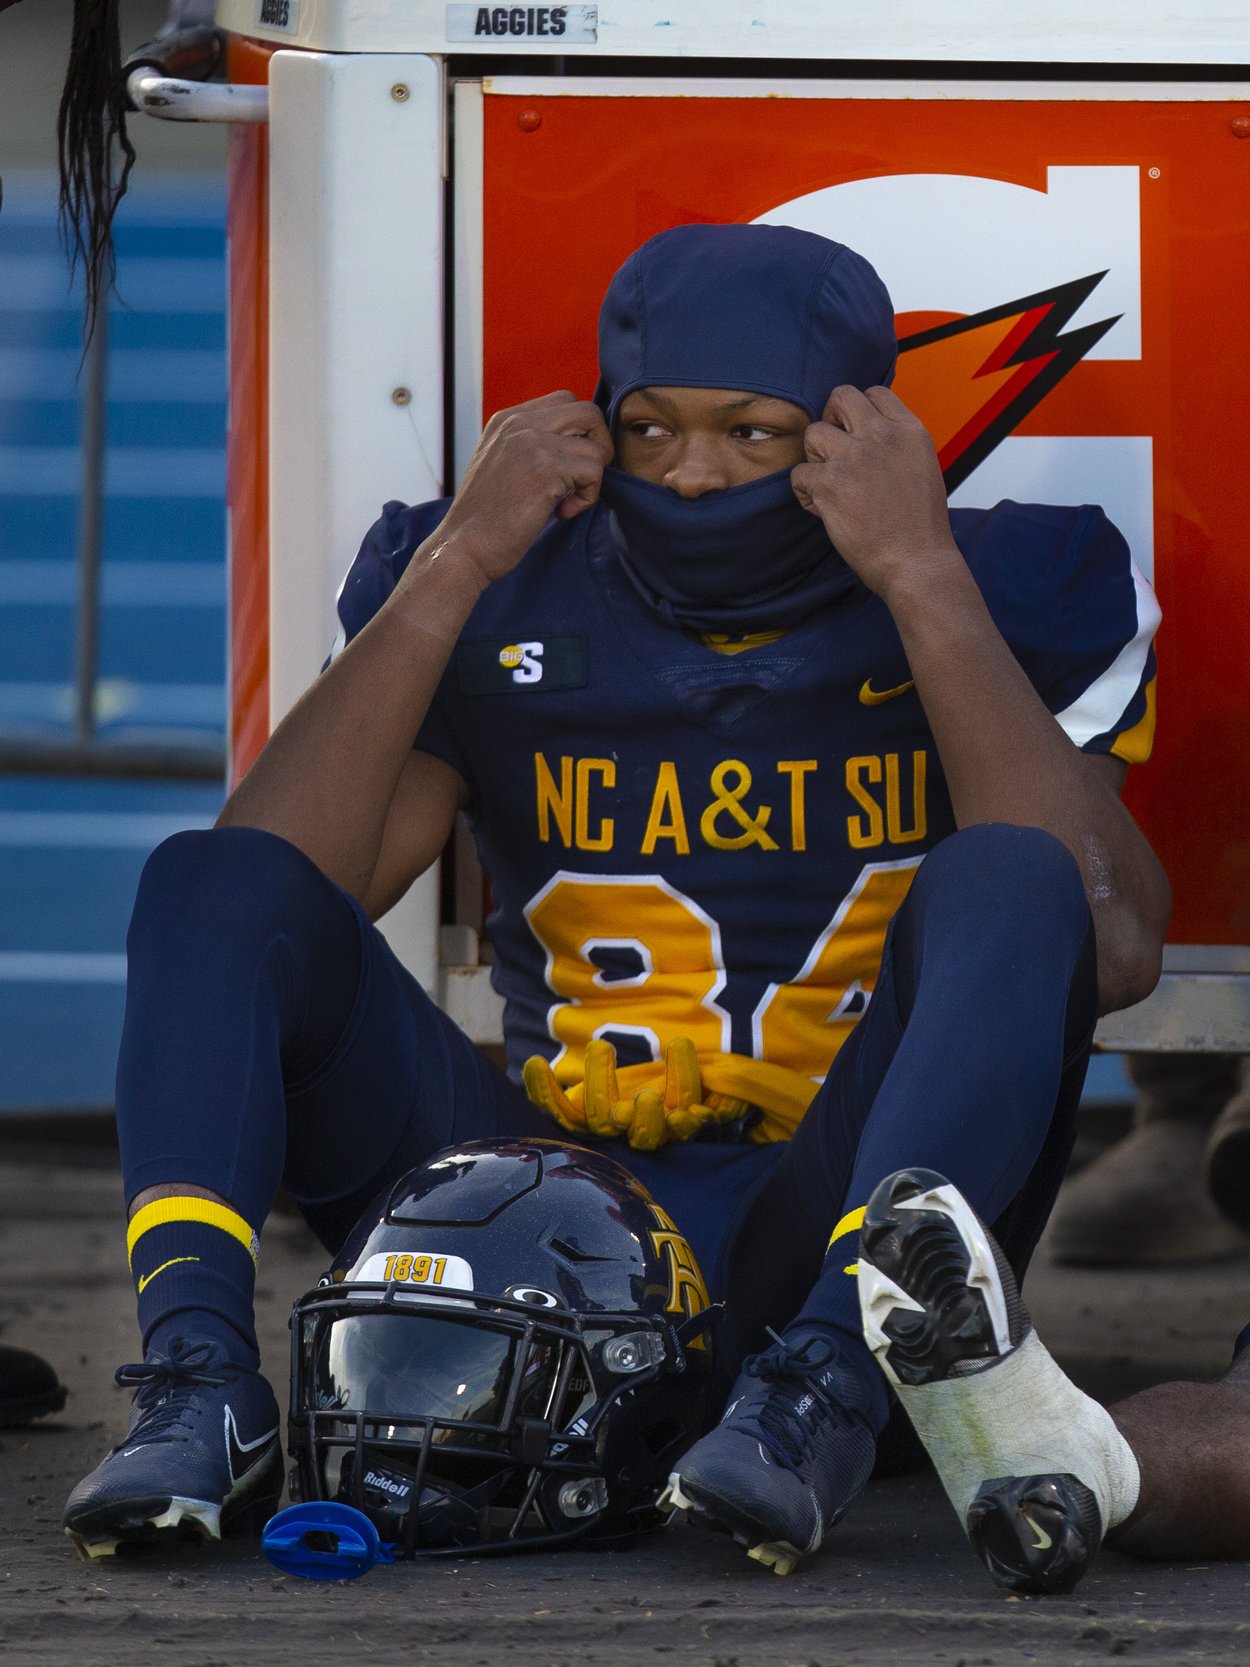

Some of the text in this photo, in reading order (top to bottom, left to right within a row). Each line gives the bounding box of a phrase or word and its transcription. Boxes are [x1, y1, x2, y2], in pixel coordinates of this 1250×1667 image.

[261, 0, 289, 27] AGGIES
[475, 7, 567, 36] AGGIES
[535, 750, 928, 856] NC A&T SU
[522, 853, 928, 1085] 84
[384, 1254, 447, 1285] 1891
[363, 1471, 410, 1497] Riddell
